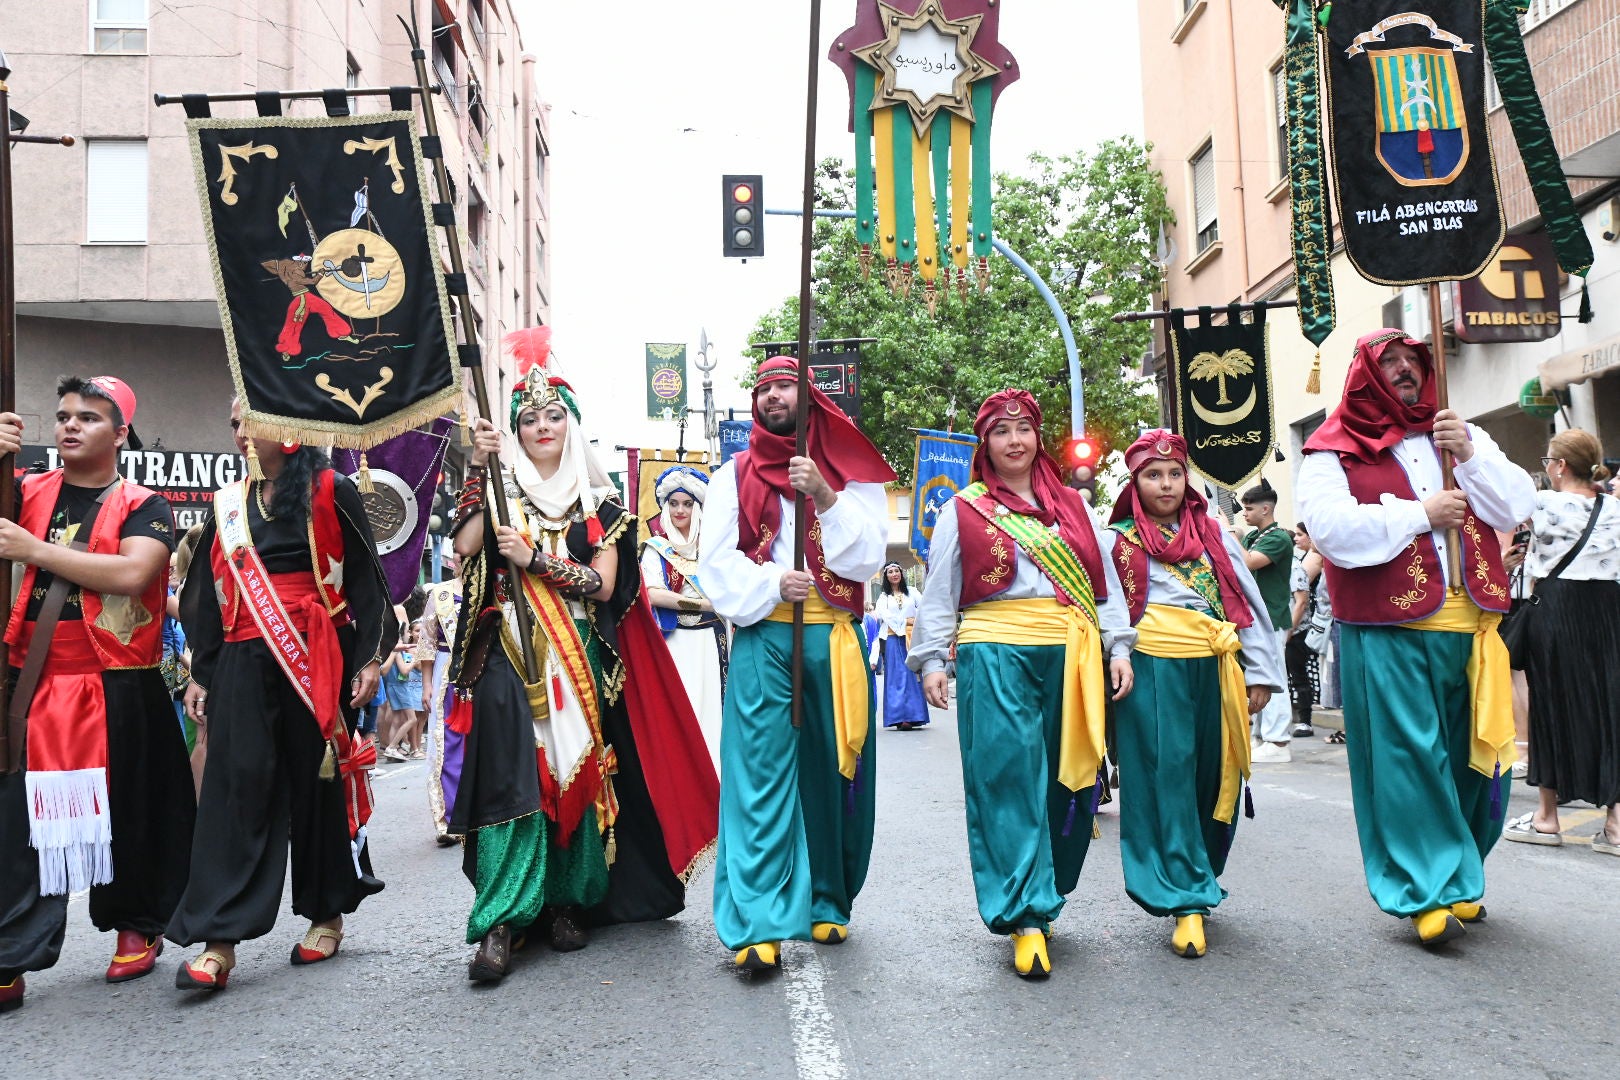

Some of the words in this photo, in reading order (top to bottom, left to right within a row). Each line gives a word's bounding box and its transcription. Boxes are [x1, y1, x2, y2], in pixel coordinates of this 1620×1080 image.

[1356, 204, 1391, 224] FILÁ
[1400, 219, 1428, 235] SAN
[1433, 216, 1464, 231] BLAS
[1466, 311, 1560, 326] TABACOS
[1582, 343, 1620, 374] TABAC
[190, 491, 199, 502] Y
[200, 491, 215, 502] VI
[244, 569, 300, 663] ABANDERADA
